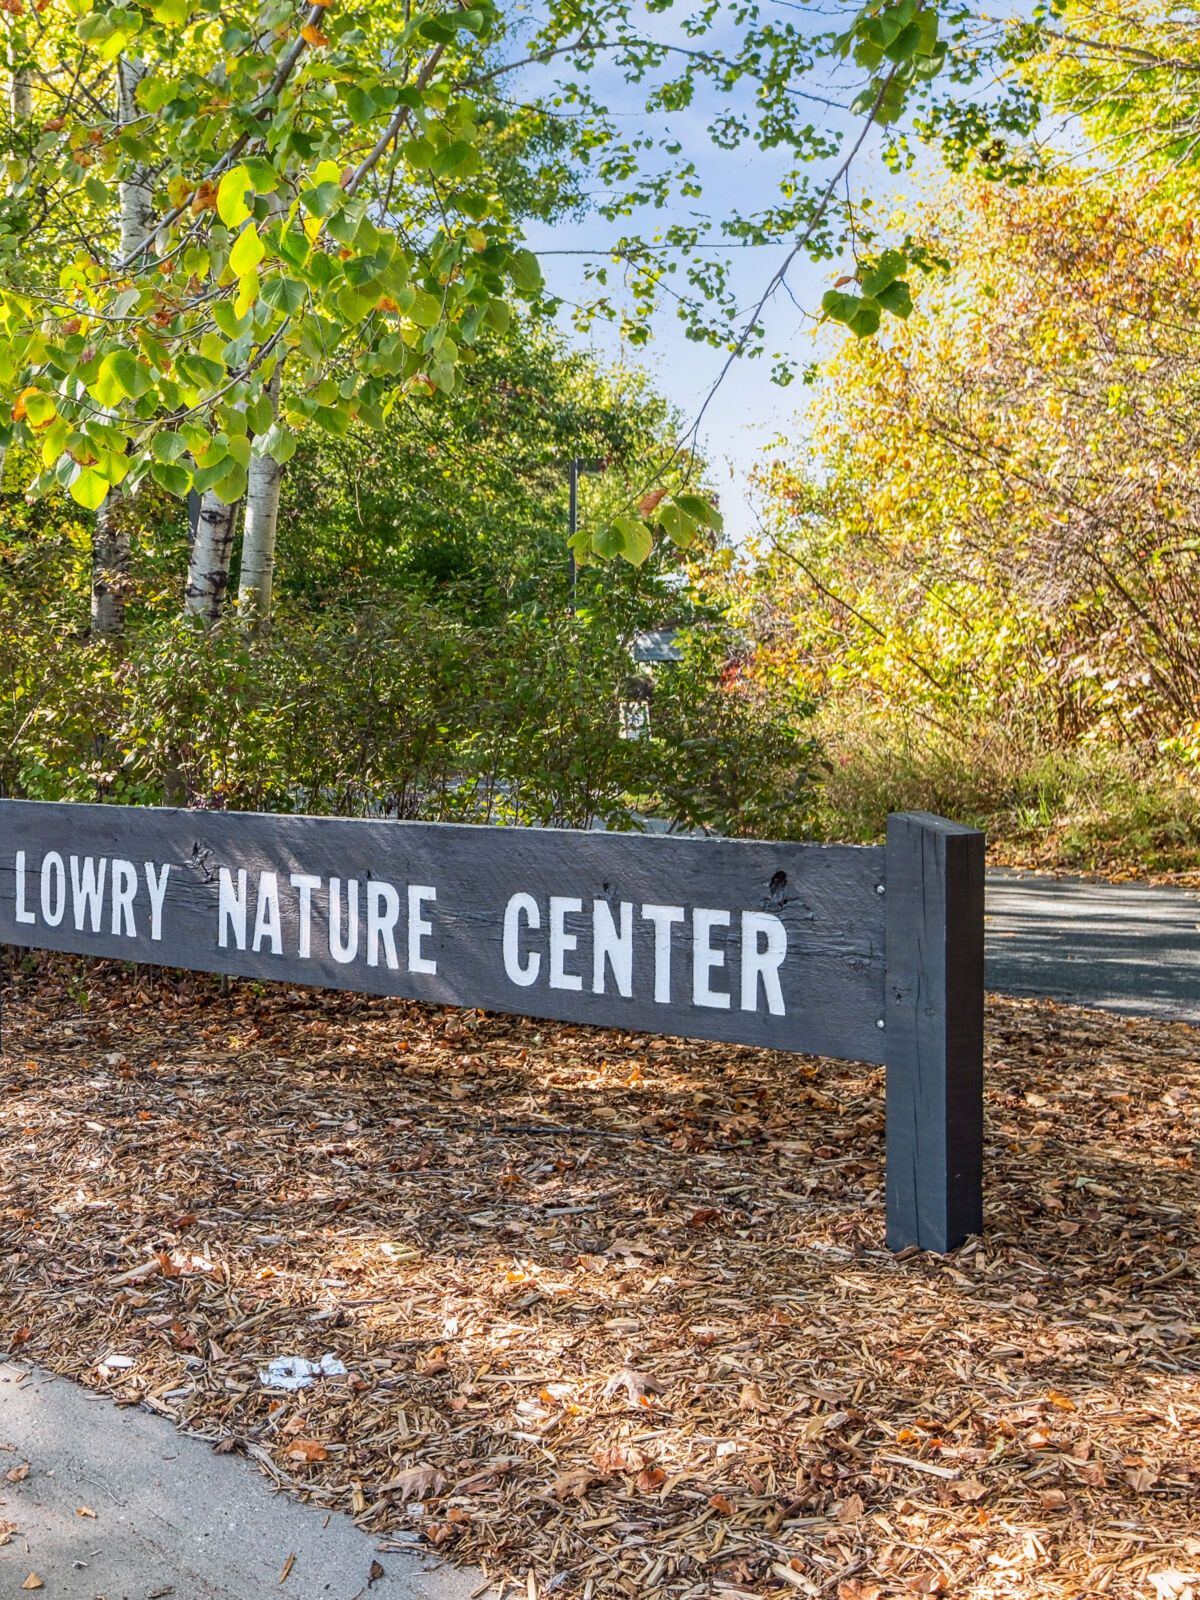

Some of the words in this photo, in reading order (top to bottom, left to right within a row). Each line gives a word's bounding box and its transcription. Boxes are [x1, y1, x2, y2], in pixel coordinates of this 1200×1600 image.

[14, 849, 171, 941] LOWRY
[218, 867, 437, 976] NATURE
[503, 892, 788, 1016] CENTER
